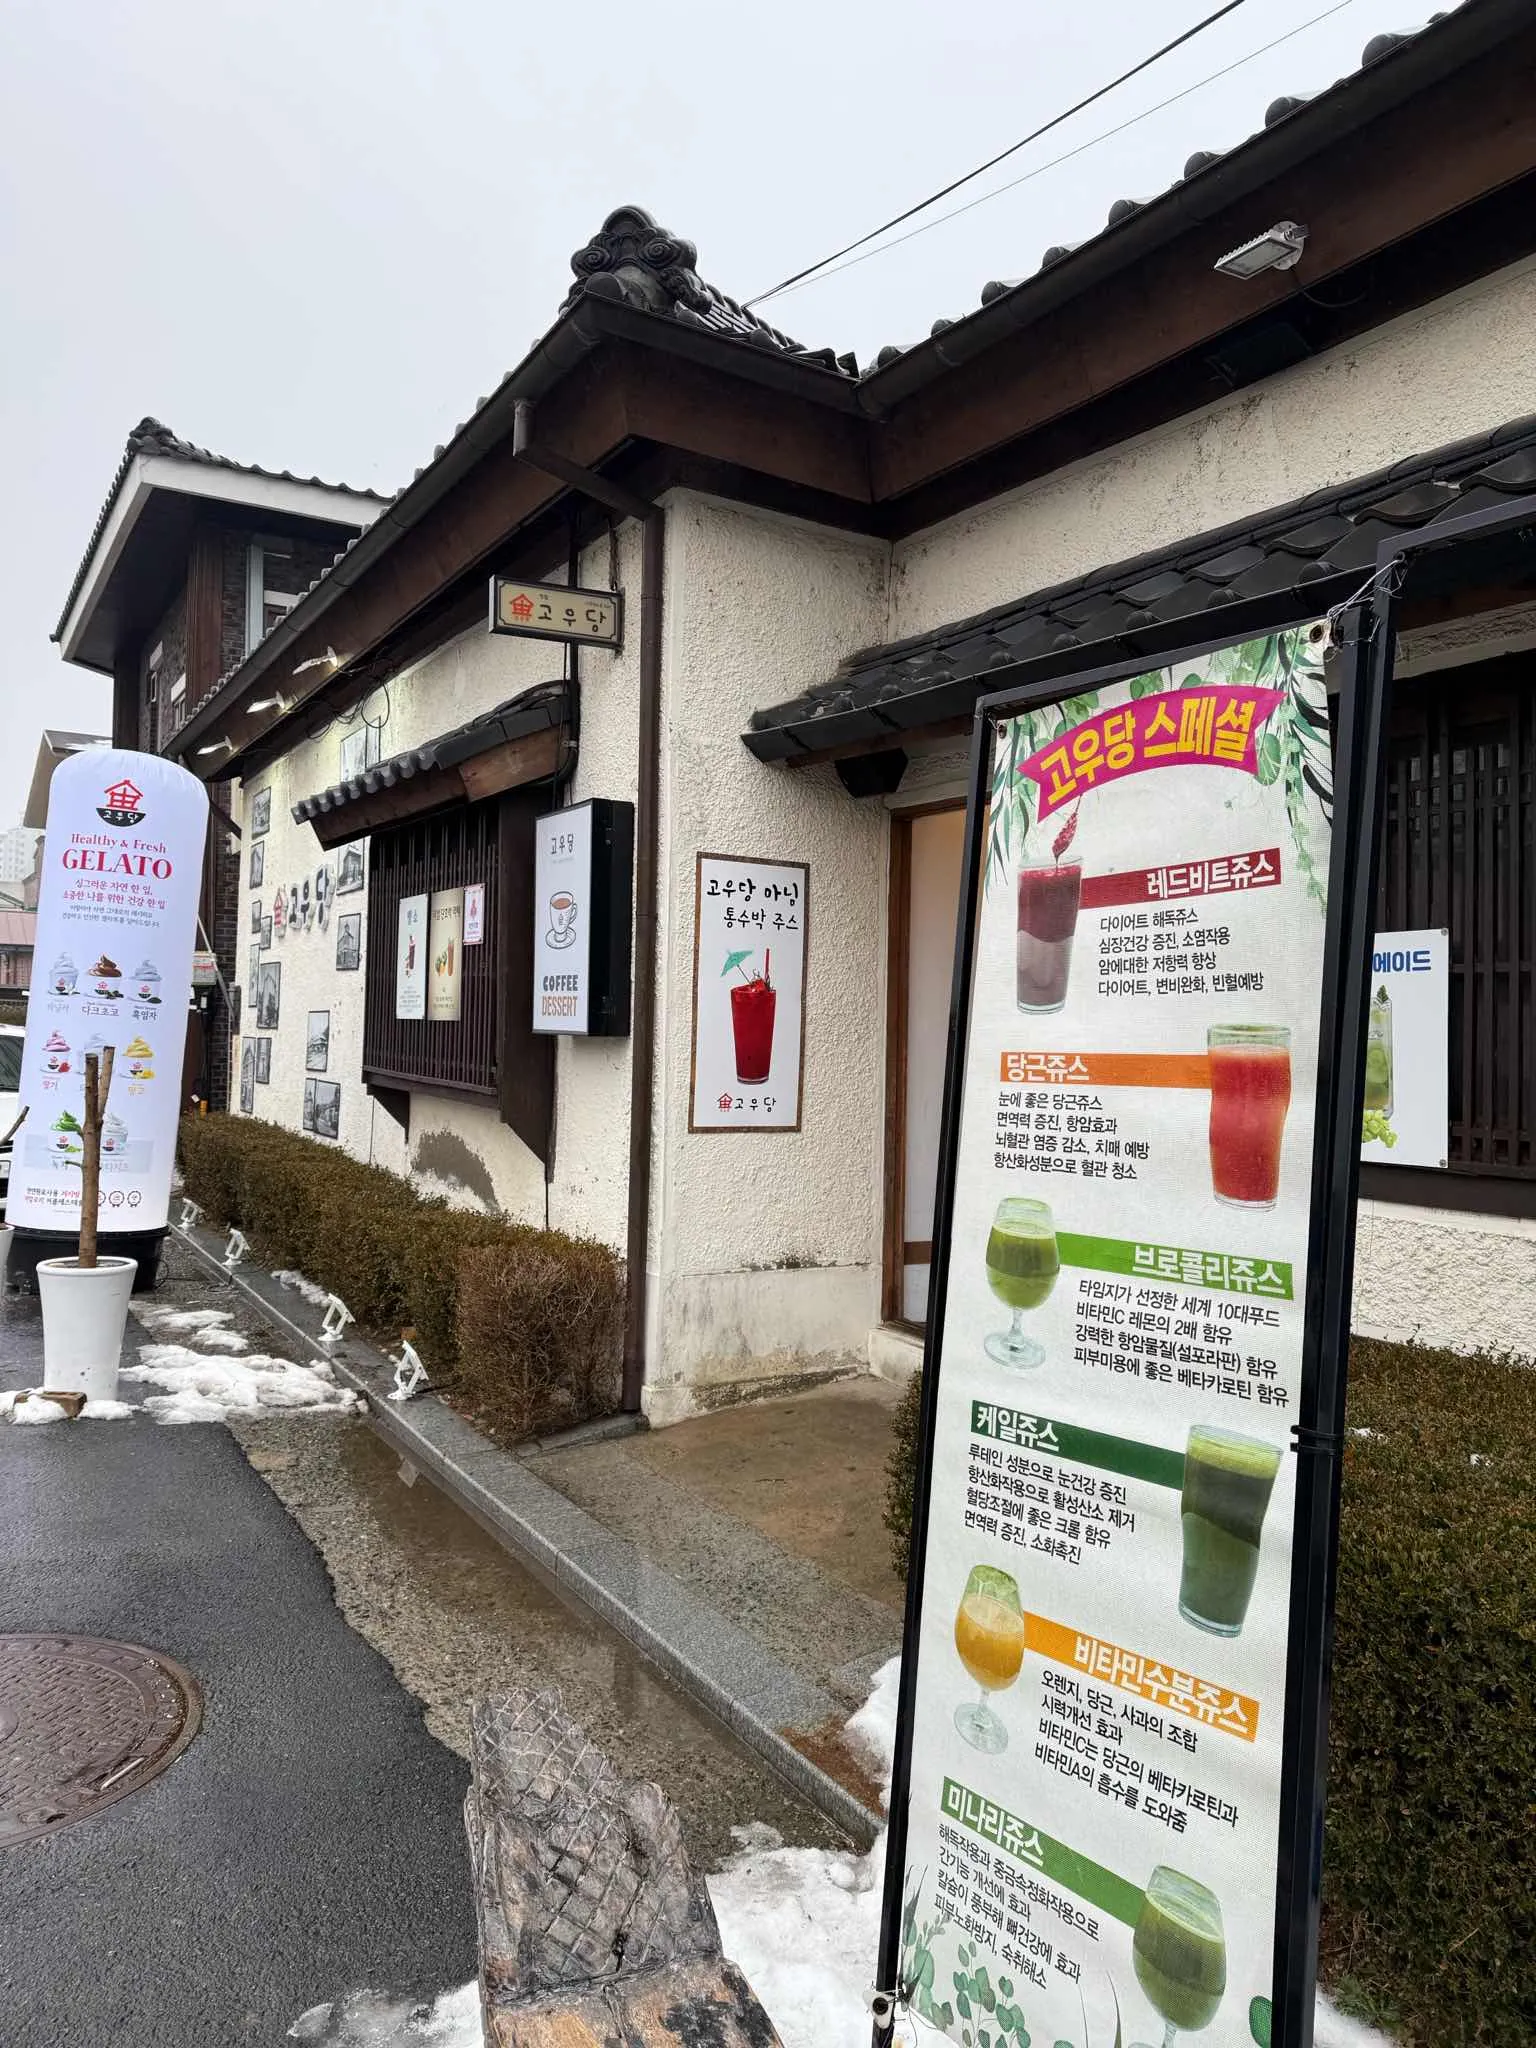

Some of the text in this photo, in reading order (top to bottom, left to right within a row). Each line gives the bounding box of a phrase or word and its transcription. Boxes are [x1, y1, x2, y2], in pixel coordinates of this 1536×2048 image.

[538, 603, 607, 632] 고우당
[1040, 696, 1256, 805] 고우당 스페셜
[103, 809, 139, 824] 고우당
[63, 849, 172, 880] GELATO
[72, 834, 166, 853] Healthy & Fresh
[551, 834, 574, 855] 고우당
[707, 878, 798, 906] 고우당 아닝
[1147, 854, 1275, 898] 레드비트쥬스
[724, 907, 798, 930] 통수박 주스
[1099, 926, 1231, 954] 심장건강 증진, 소염작용
[1100, 907, 1199, 932] 다이어트 해독쥬스
[543, 974, 578, 992] COFFEE
[1098, 972, 1264, 997] 다이어트, 변비완화, 빈혈예방
[1099, 952, 1217, 975] 암에대한 저항력 향상
[542, 996, 577, 1017] DESSERT
[1007, 1054, 1089, 1081] 당근쥬스
[734, 1097, 777, 1113] 고우당
[997, 1112, 1117, 1134] 면역력 증진, 항암효과
[998, 1092, 1103, 1112] 눈에 좋은 당근쥬스
[994, 1152, 1138, 1180] 항산화성분으로 혈관 청소
[995, 1132, 1150, 1160] 뇌혈관 염증 감소, 치매 예방
[1133, 1246, 1285, 1294] 브로콜리쥬스
[1076, 1302, 1232, 1345] 비타민C 레몬의 2배 함유
[1079, 1280, 1280, 1328] 타임지가 선정한 세계 10대푸드
[1075, 1324, 1278, 1380] 강력한 항암물질(설포라판) 함유
[1073, 1347, 1290, 1408] 피부미용에 좋은 베타카로틴 함유
[977, 1405, 1059, 1452] 케일쥬스
[968, 1443, 1127, 1505] 루테인 성분으로 눈건강 증진
[966, 1487, 1111, 1549] 혈당조절에 좋은 크롬 함유
[968, 1465, 1135, 1532] 항산화작용으로 활성산소 제거
[965, 1510, 1081, 1565] 면역력 증진, 소화촉진
[1074, 1636, 1248, 1734] 비타민수분쥬스
[1041, 1670, 1199, 1753] 오렌지, 당근, 사과의 조합
[1041, 1694, 1124, 1746] 시력개선 효과
[1035, 1742, 1188, 1833] 비타민A의 흡수를 도와줌
[1038, 1718, 1239, 1828] 비타민C는 당근의 베타카로틴과
[948, 1783, 1044, 1867] 미나리쥬스
[938, 1824, 1100, 1941] 해독작용과 중금속정화작용으로
[938, 1847, 1032, 1922] 간기능 개선에 효과
[934, 1894, 1046, 1990] 피부노화방지, 숙취해소
[936, 1863, 1081, 1984] 칼슘이 풍부해 뼈건강에 효과
